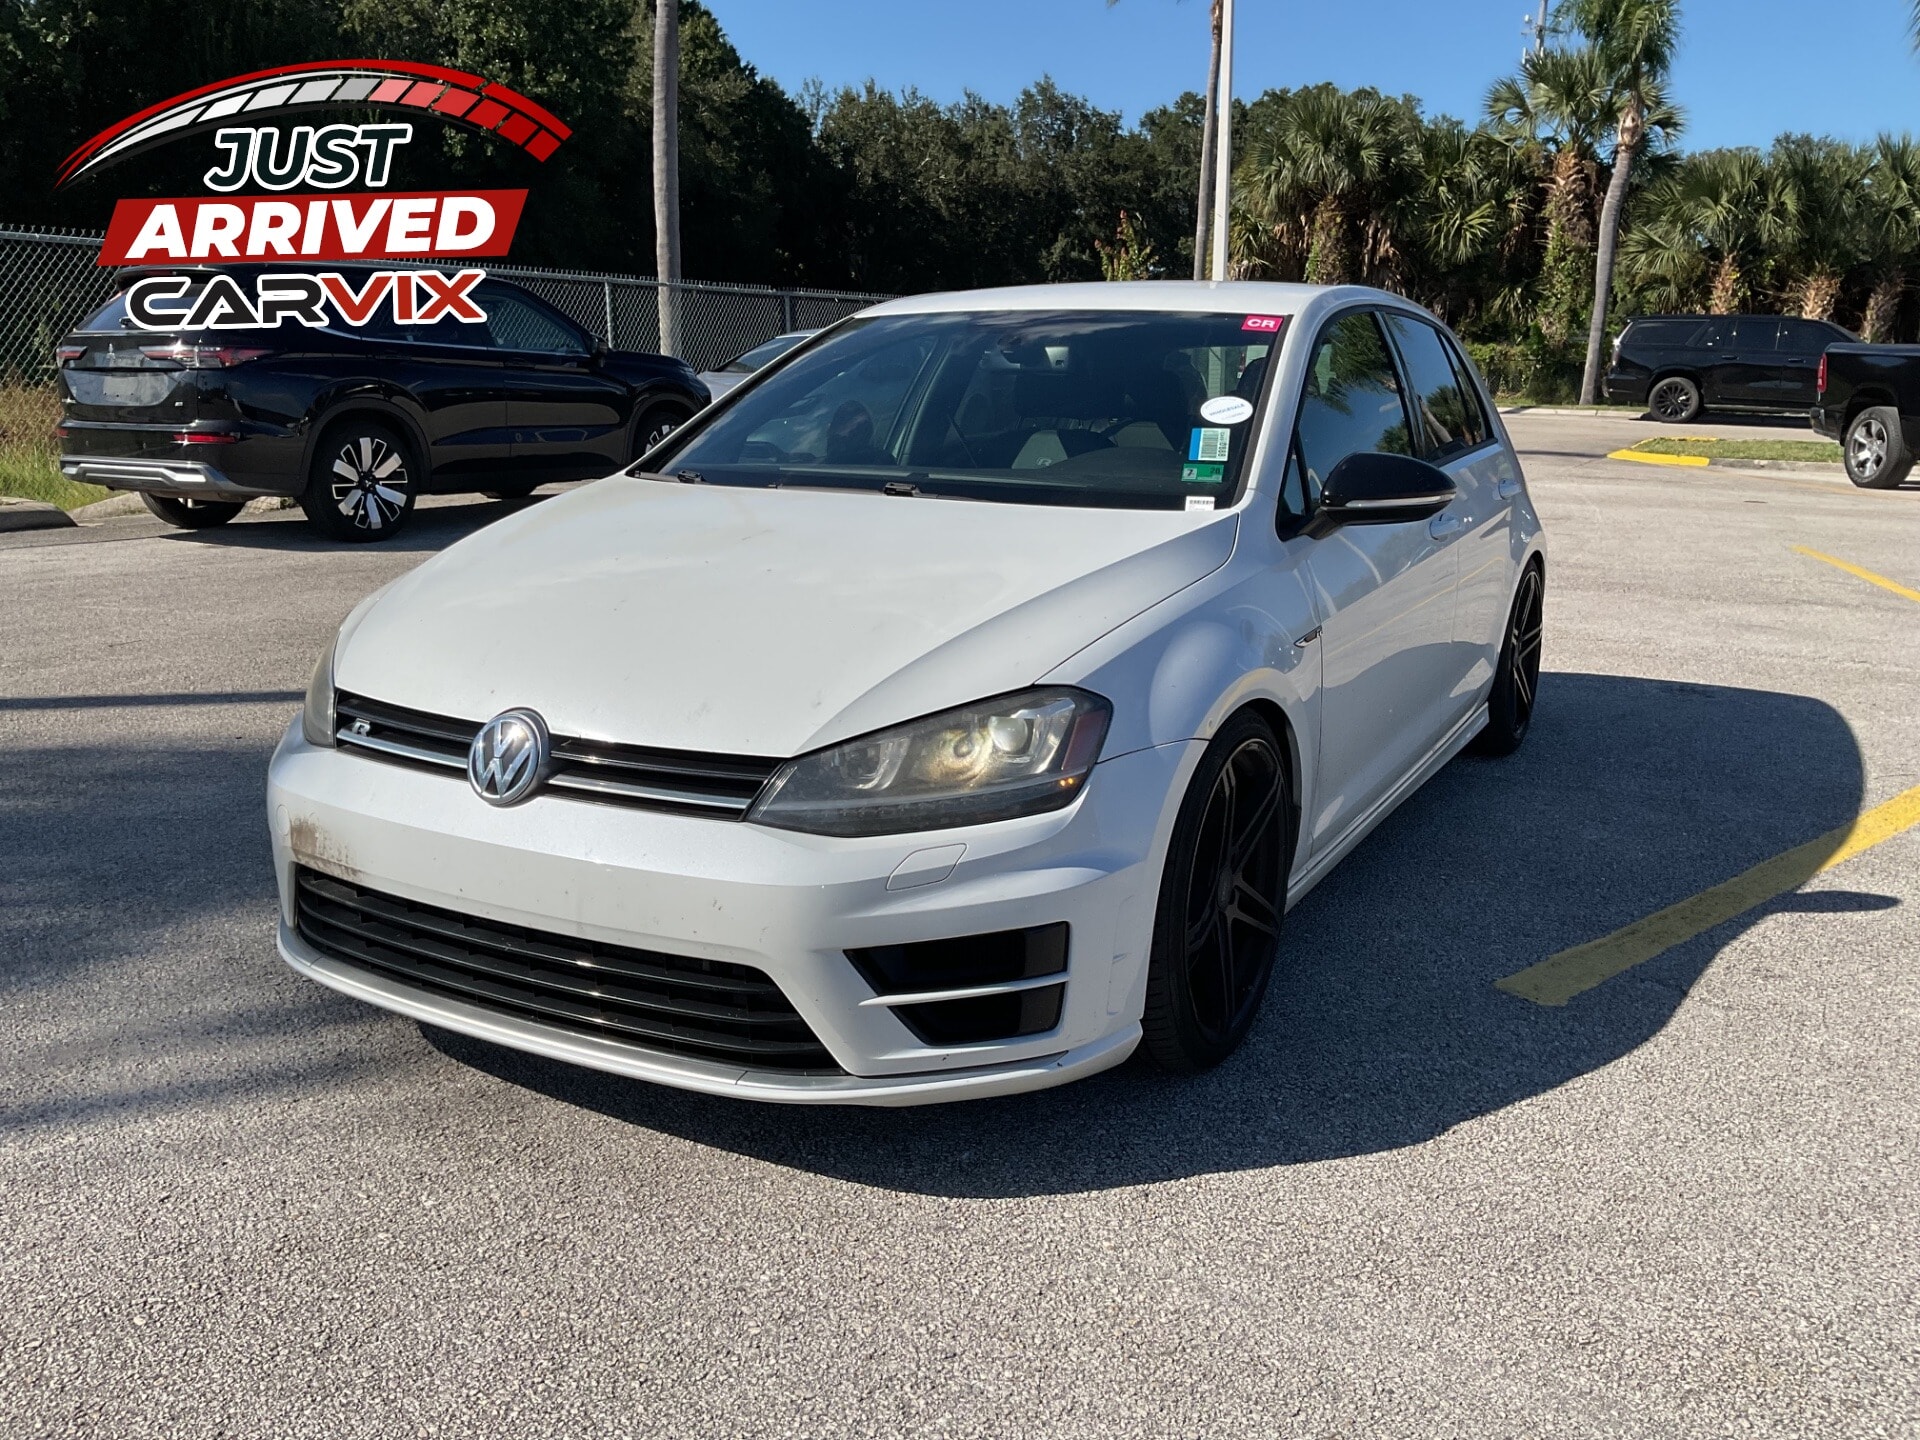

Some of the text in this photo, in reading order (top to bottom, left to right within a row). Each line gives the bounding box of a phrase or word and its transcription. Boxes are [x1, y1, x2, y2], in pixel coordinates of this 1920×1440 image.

[1247, 318, 1276, 328] CR
[352, 718, 371, 737] R
[472, 714, 540, 801] VW
